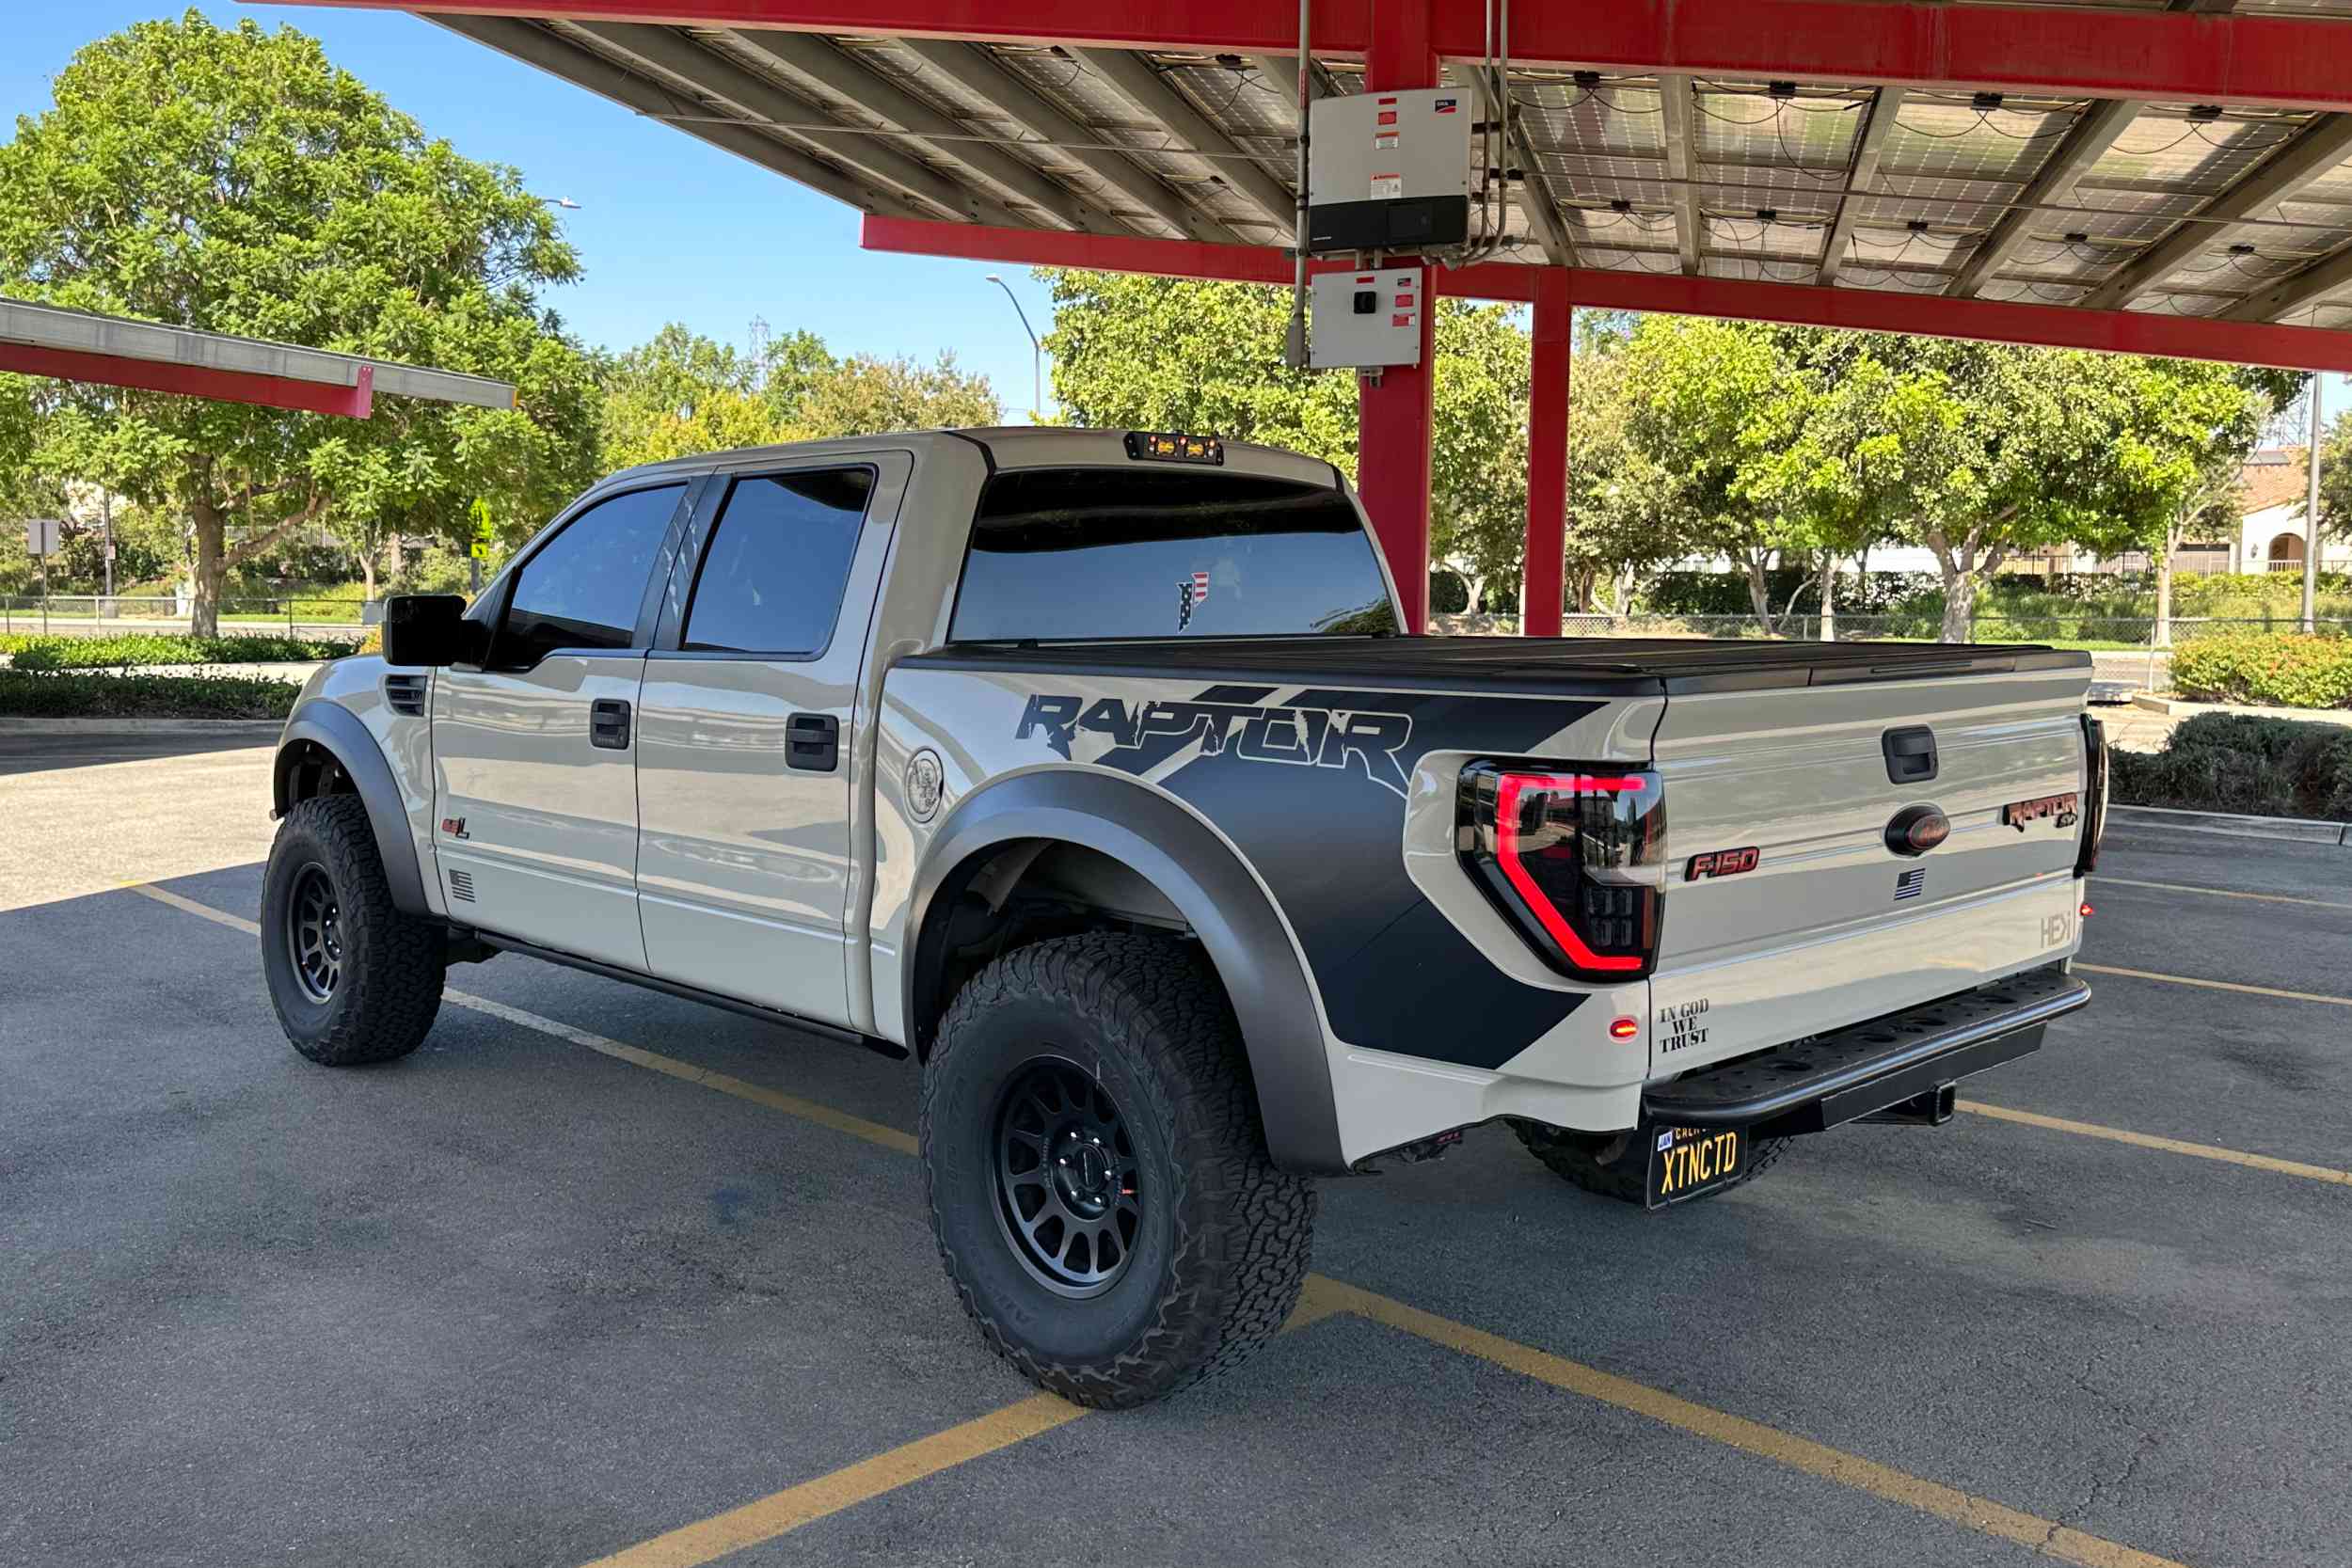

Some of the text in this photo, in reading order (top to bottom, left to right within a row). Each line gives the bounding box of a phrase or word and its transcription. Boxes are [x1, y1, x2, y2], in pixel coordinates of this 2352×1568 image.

[1015, 693, 1413, 800] RAPTOR
[1660, 998, 1709, 1023] IN GOD
[1672, 1016, 1697, 1035] WE
[1659, 1027, 1709, 1054] TRUST
[1661, 1132, 1737, 1195] XTNCTD
